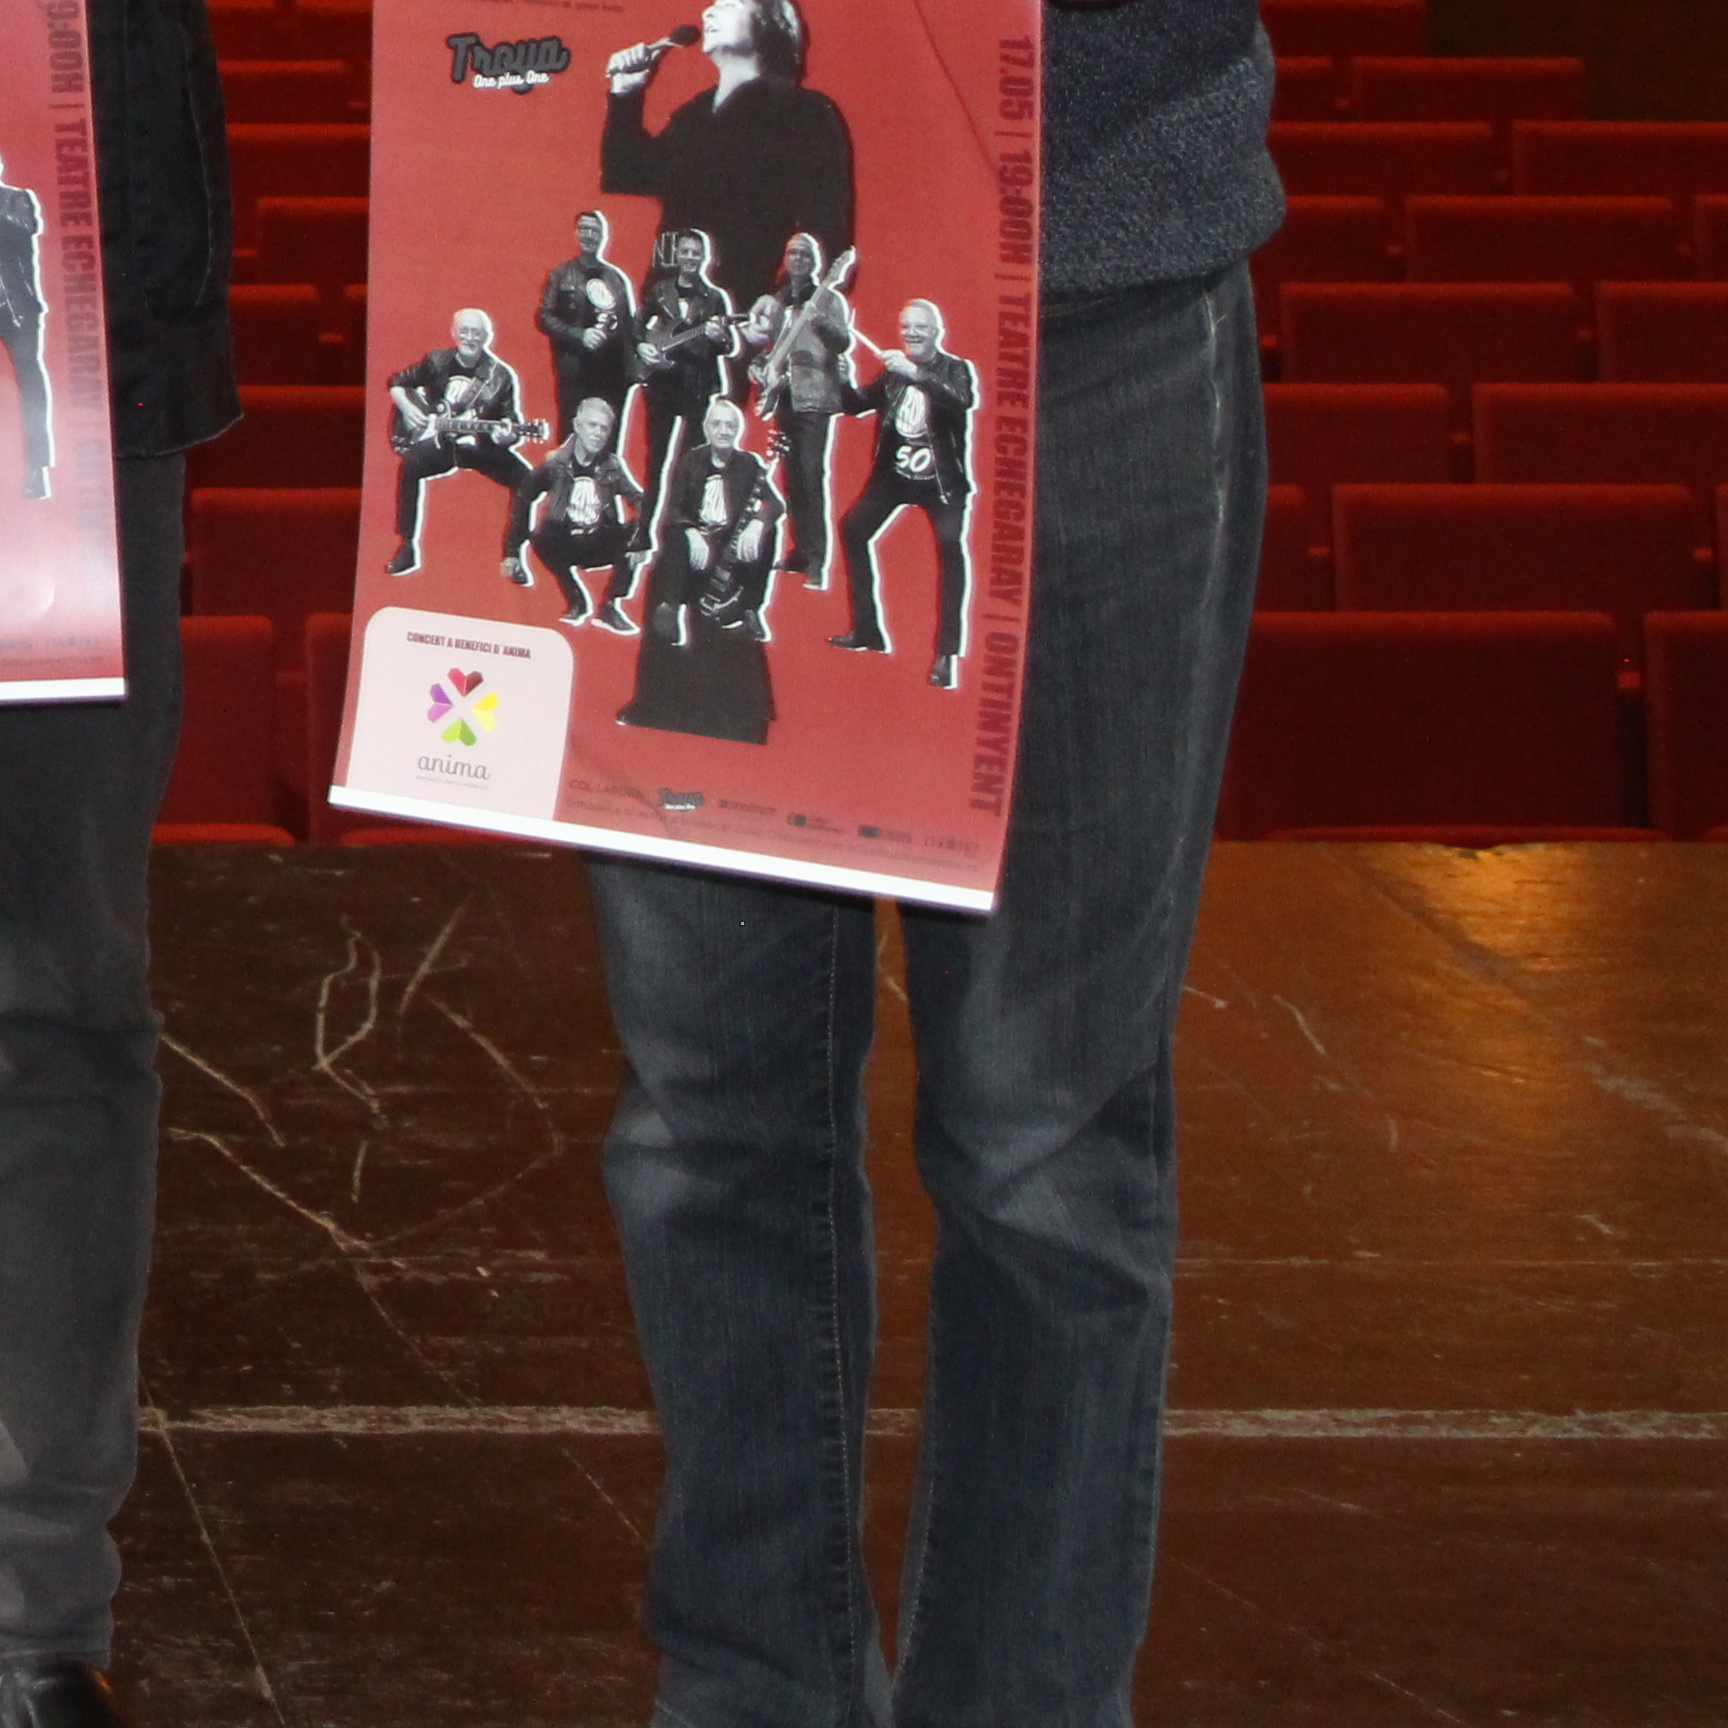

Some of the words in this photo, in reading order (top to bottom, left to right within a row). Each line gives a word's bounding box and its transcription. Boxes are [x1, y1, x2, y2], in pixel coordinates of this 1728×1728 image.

[473, 74, 496, 88] One
[498, 71, 524, 89] plus
[526, 69, 550, 84] One
[894, 445, 931, 472] 50
[418, 754, 491, 780] anima
